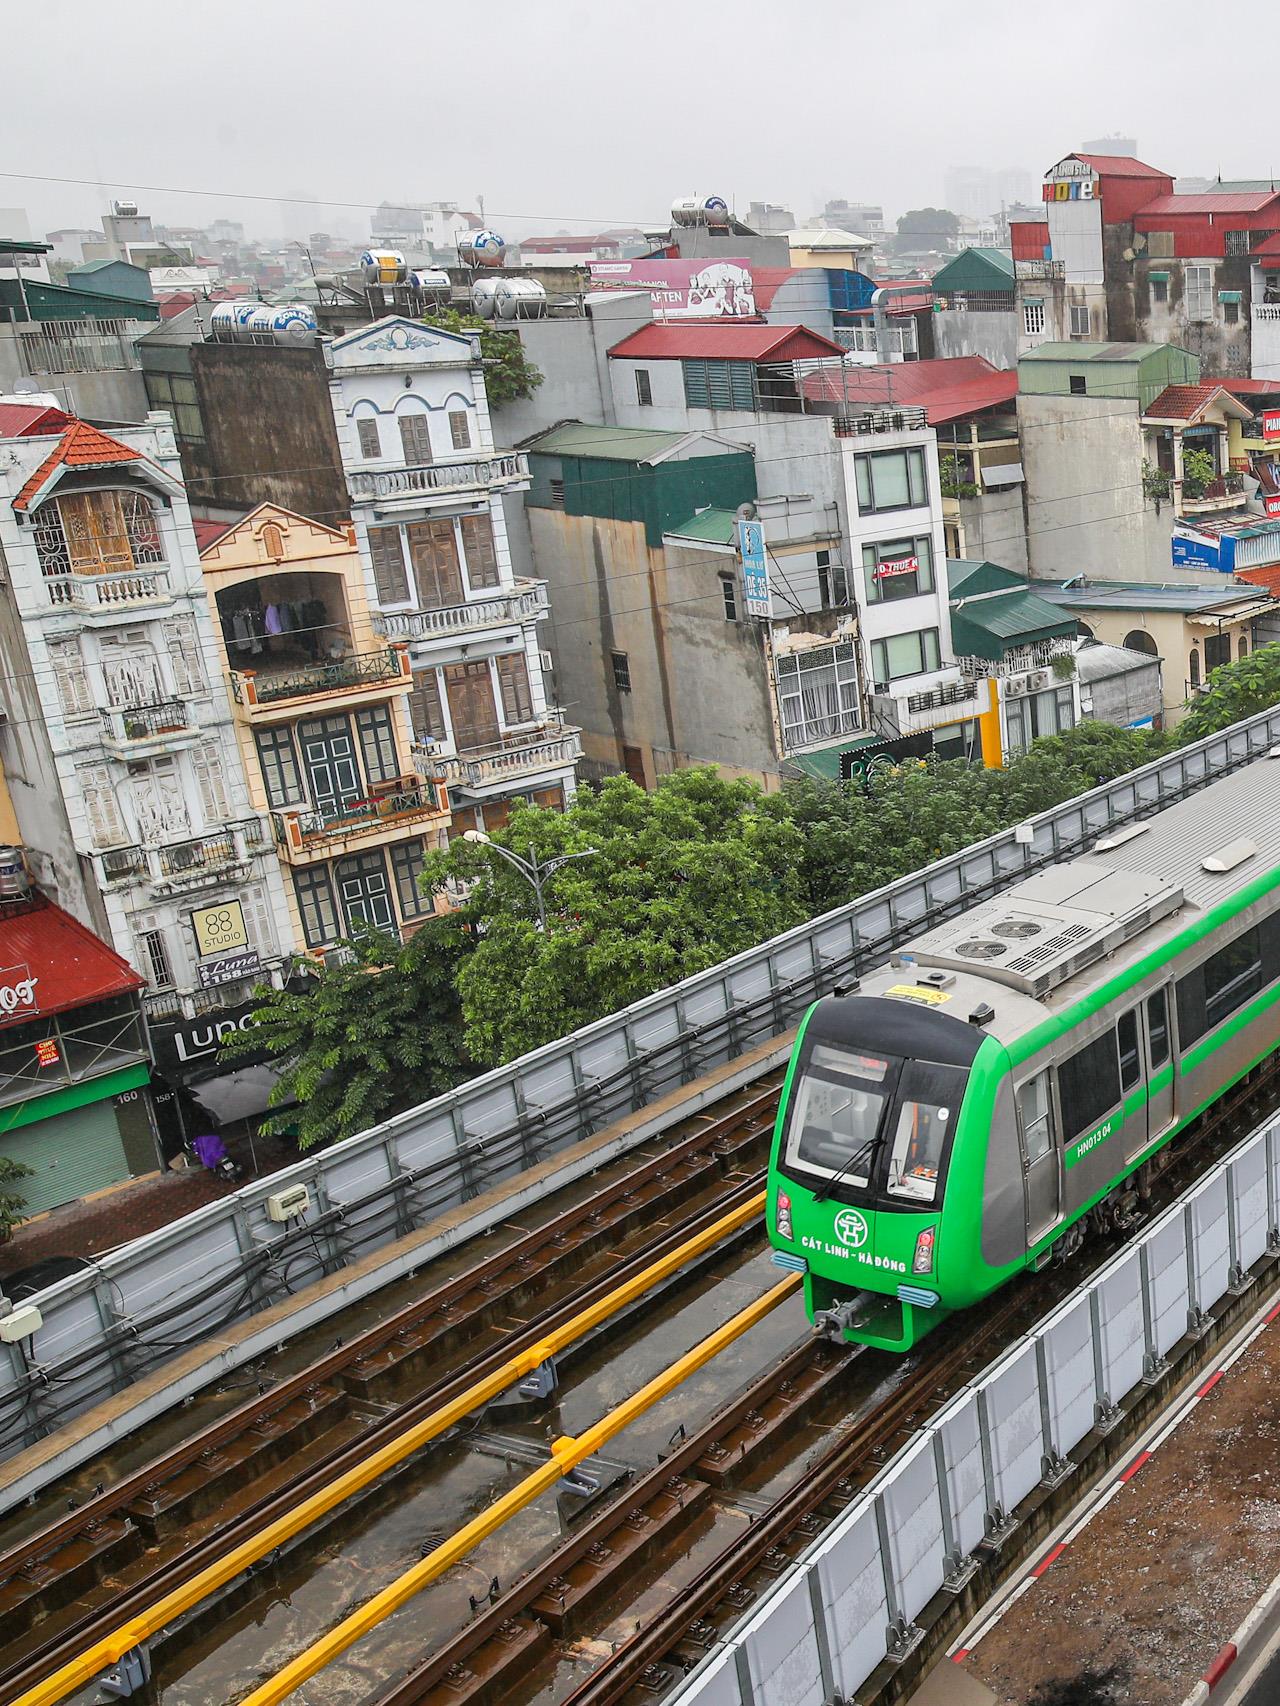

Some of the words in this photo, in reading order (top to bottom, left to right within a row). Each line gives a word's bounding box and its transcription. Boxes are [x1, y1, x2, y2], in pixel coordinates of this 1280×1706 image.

[749, 601, 769, 615] 150
[206, 910, 233, 936] 88
[204, 931, 241, 948] STUDIO
[210, 955, 258, 976] Luna
[211, 969, 242, 984] 158
[117, 1089, 138, 1105] 160
[155, 1092, 171, 1104] 158
[1076, 1130, 1102, 1158] HN013
[1102, 1121, 1112, 1138] 04
[801, 1235, 822, 1251] CÁT
[824, 1243, 850, 1259] LINH
[858, 1251, 874, 1266] HÀ
[874, 1256, 907, 1273] ĐÔNG
